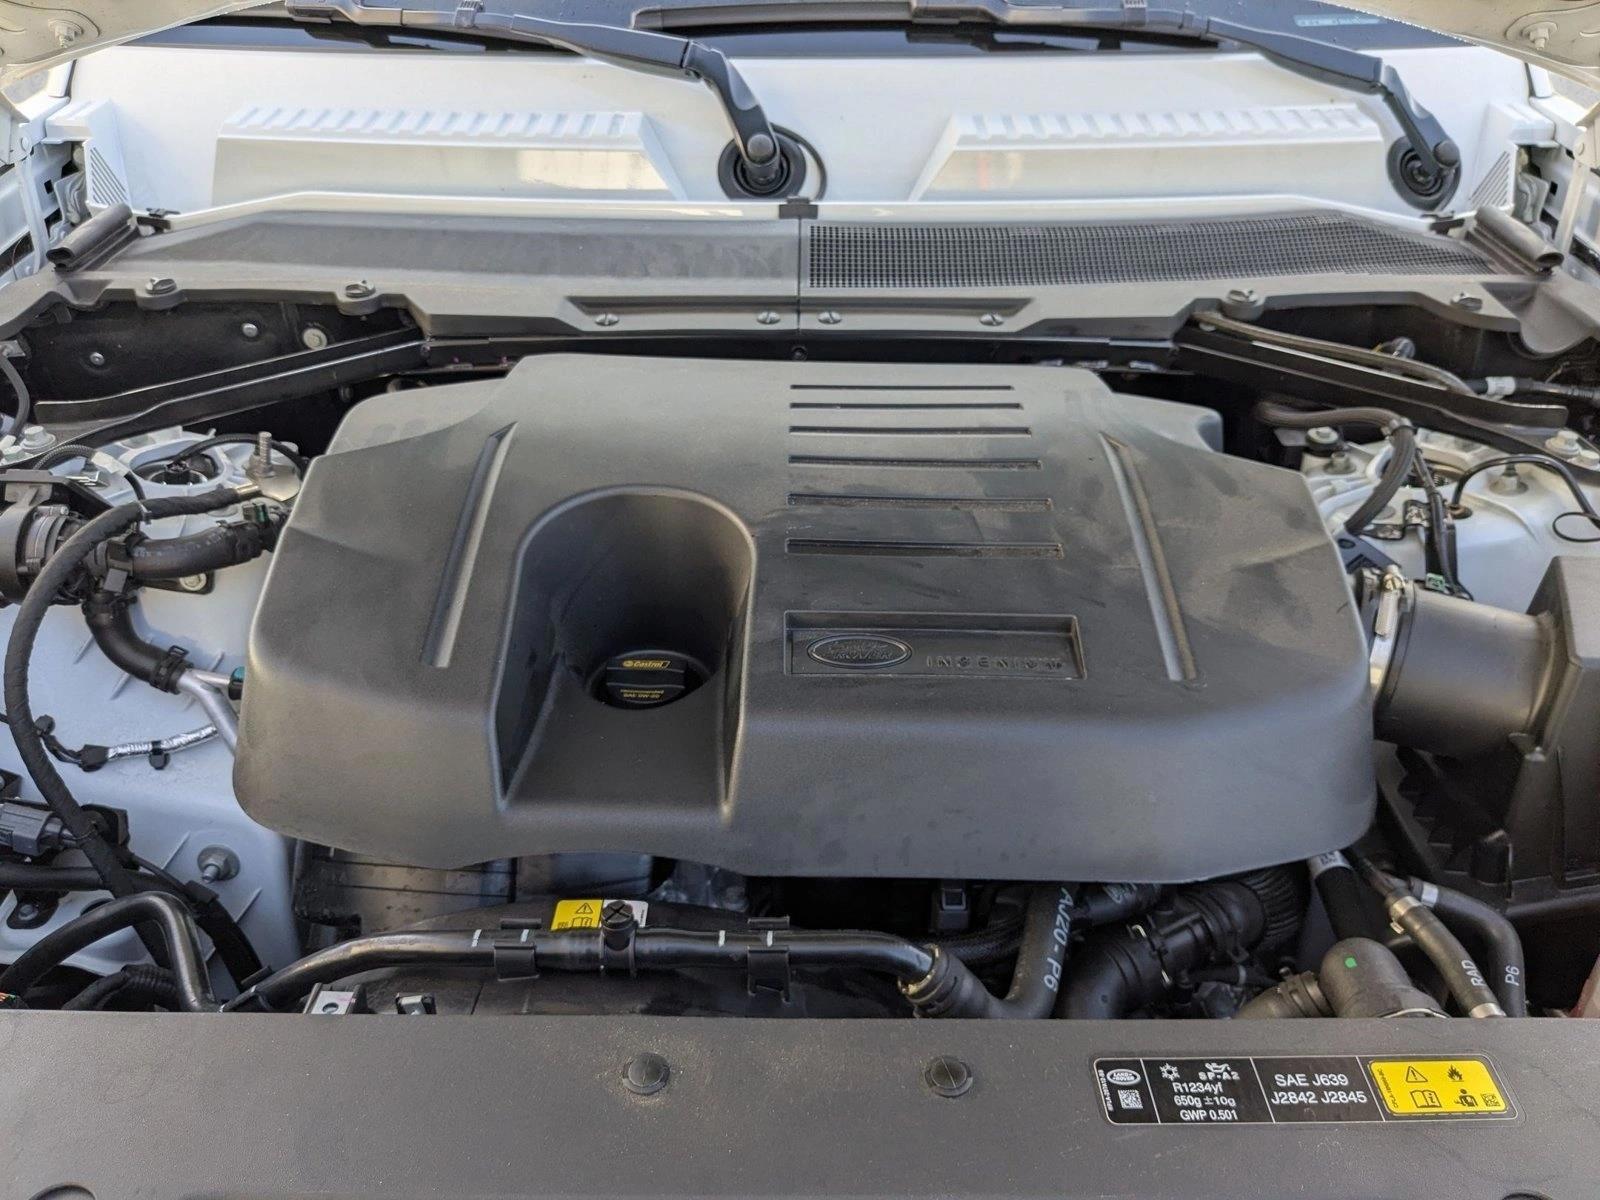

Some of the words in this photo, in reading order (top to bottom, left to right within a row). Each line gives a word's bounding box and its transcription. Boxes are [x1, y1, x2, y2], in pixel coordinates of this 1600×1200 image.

[633, 660, 663, 669] Castrol
[1461, 959, 1487, 986] RAD
[1505, 964, 1520, 986] P6
[1274, 1073, 1310, 1087] SAE
[1312, 1073, 1349, 1086] J639
[1172, 1082, 1224, 1095] R1234yf
[1174, 1095, 1203, 1108] 650g
[1271, 1091, 1318, 1104] J2842
[1321, 1091, 1367, 1104] J2845
[1180, 1109, 1207, 1120] GWP
[1209, 1109, 1238, 1120] 0.501
